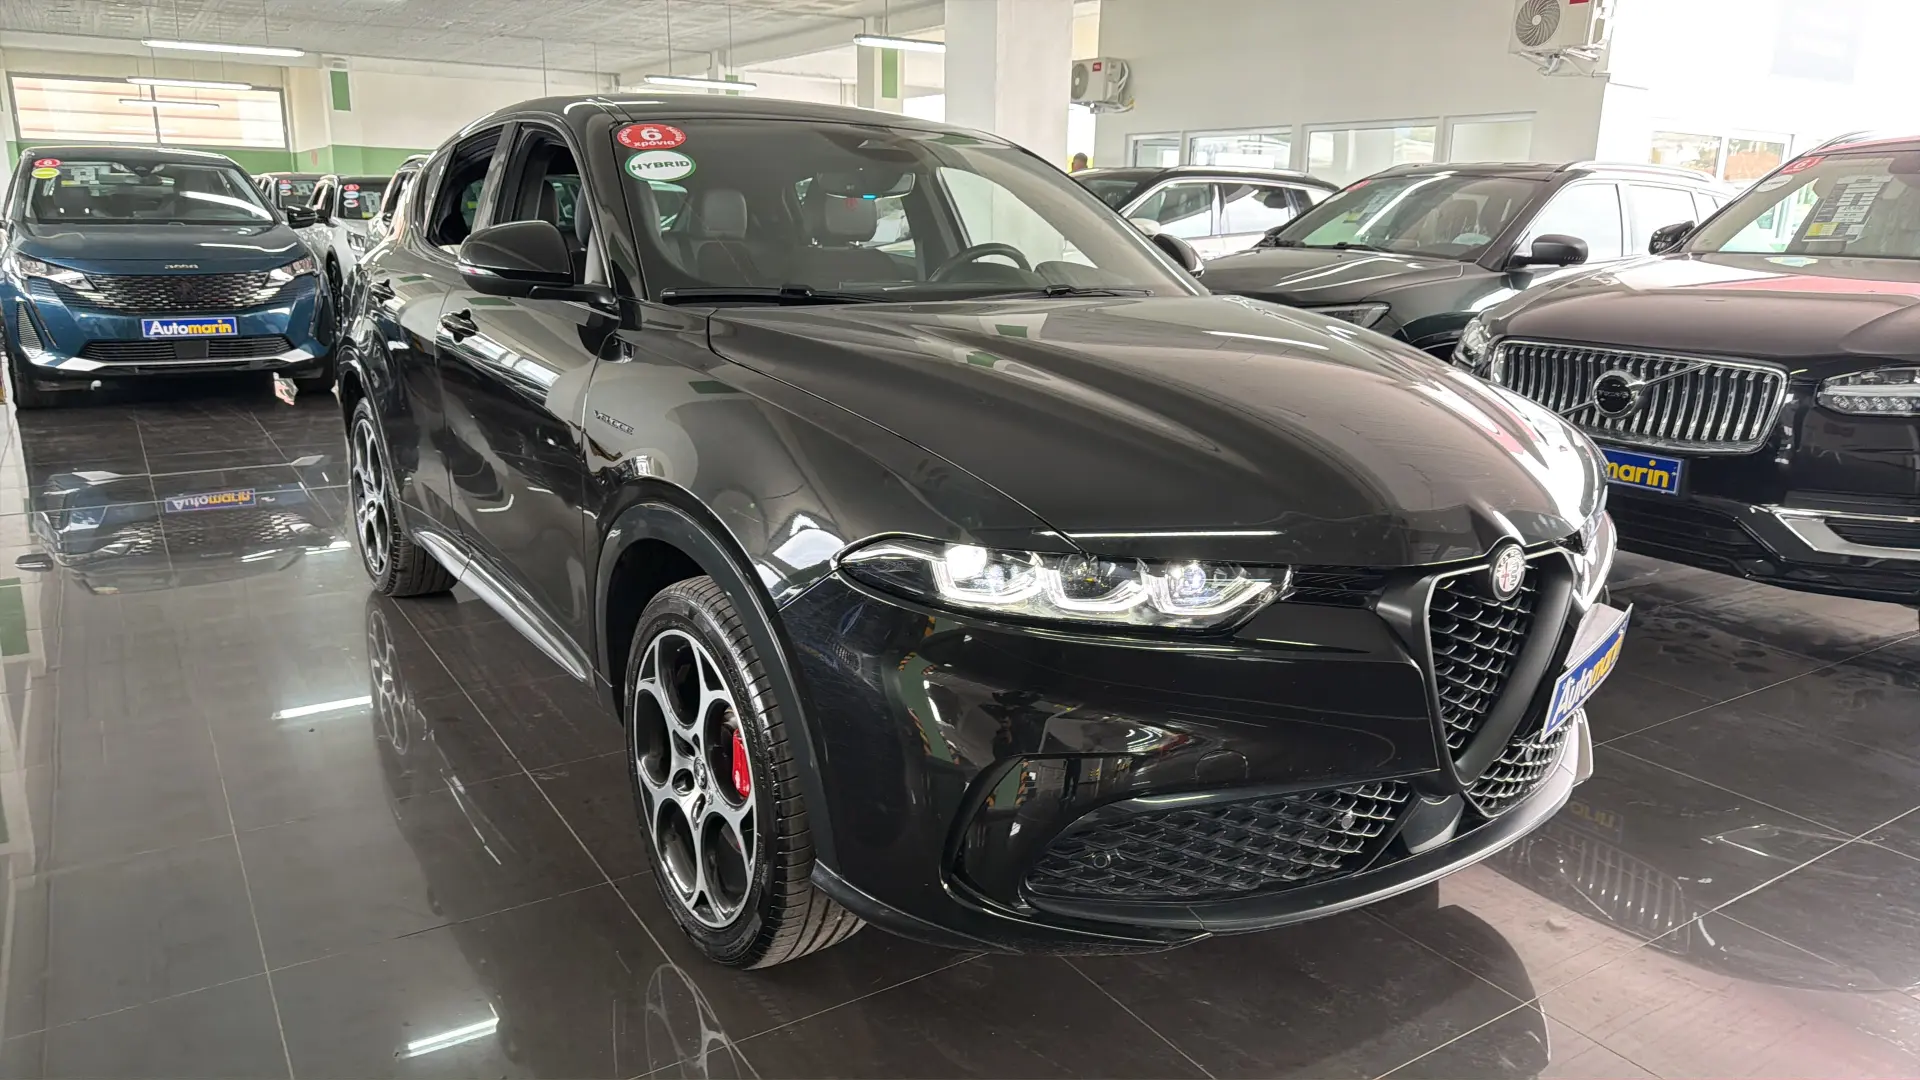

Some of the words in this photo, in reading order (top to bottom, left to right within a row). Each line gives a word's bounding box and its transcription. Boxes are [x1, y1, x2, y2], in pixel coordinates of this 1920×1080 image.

[641, 128, 662, 141] 6
[631, 160, 690, 171] HYBRID
[149, 319, 232, 335] Automarin
